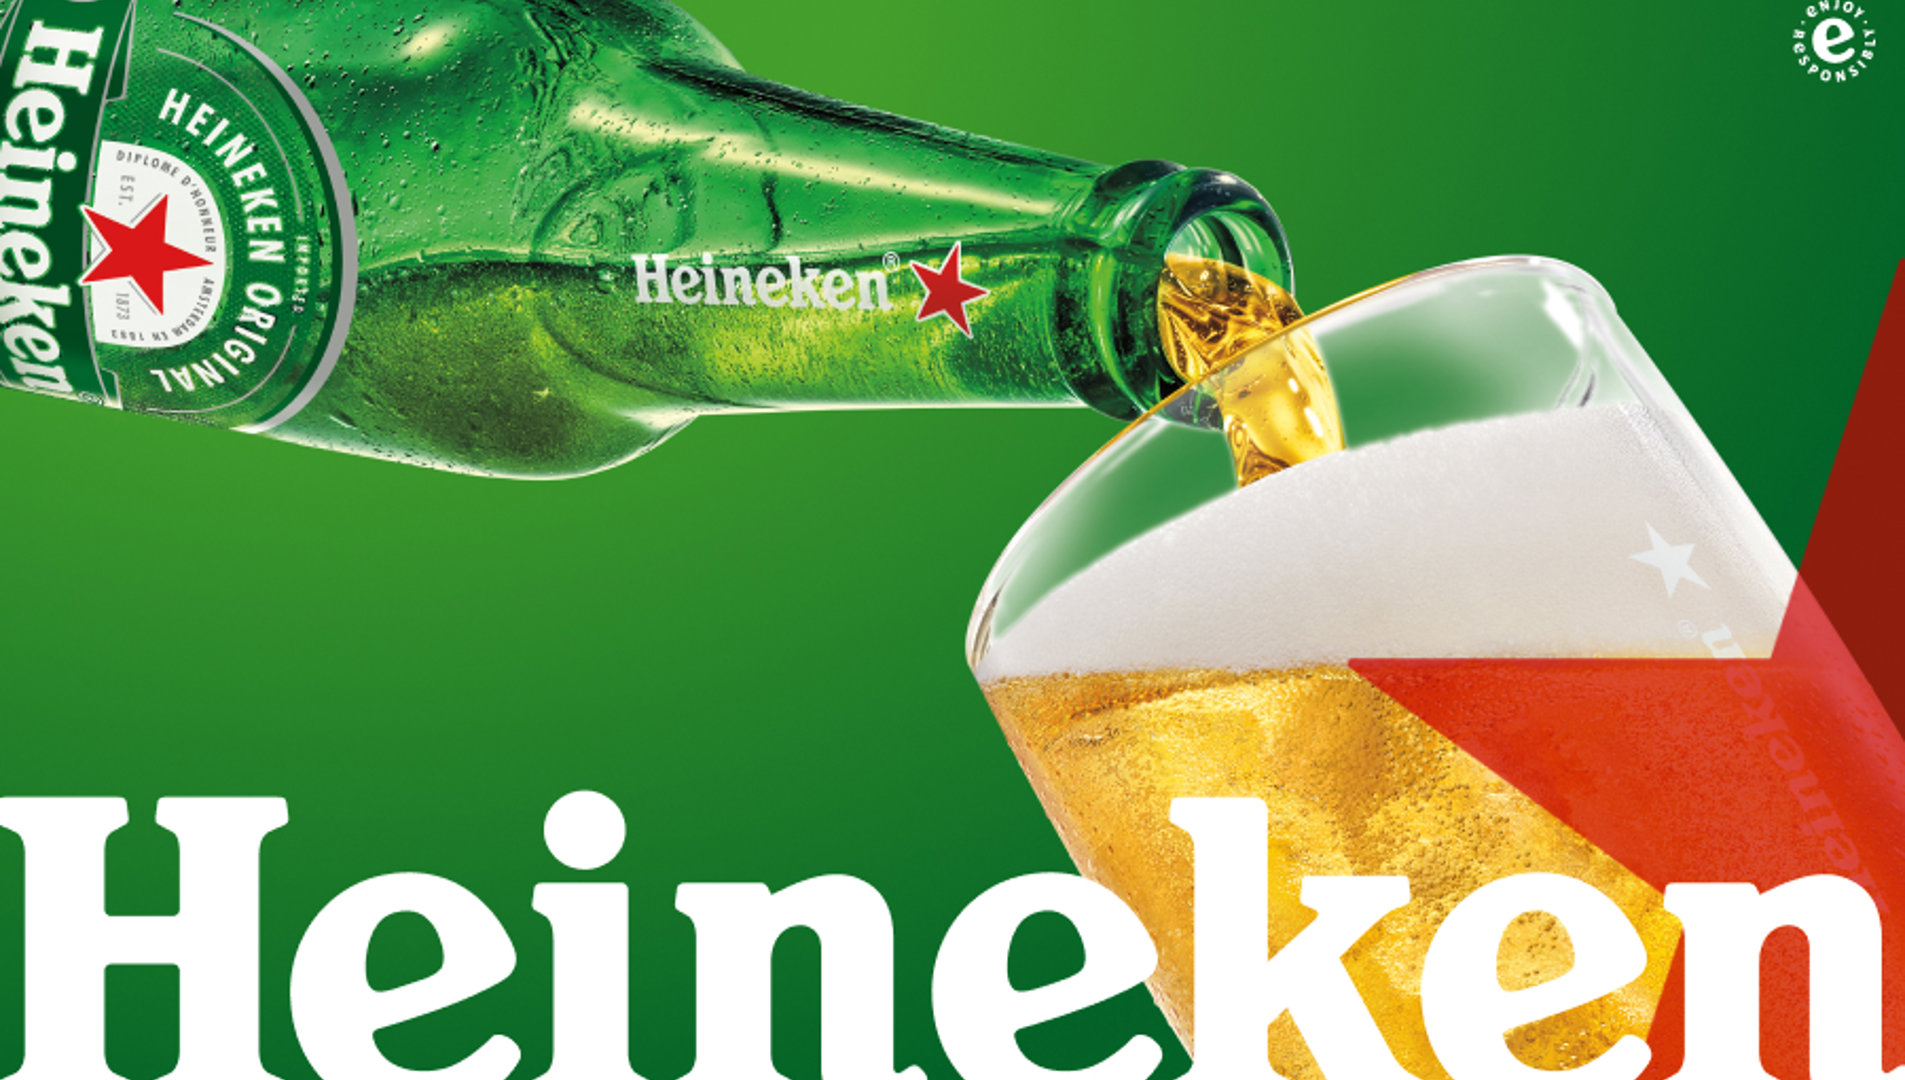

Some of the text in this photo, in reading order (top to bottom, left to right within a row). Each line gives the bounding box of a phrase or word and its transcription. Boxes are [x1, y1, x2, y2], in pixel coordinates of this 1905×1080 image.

[0, 20, 104, 393] Heineken
[116, 149, 181, 177] DIPLOME
[116, 292, 131, 321] 1873
[150, 88, 286, 393] HEINEKEN ORIGINAL
[1701, 623, 1891, 914] eineken
